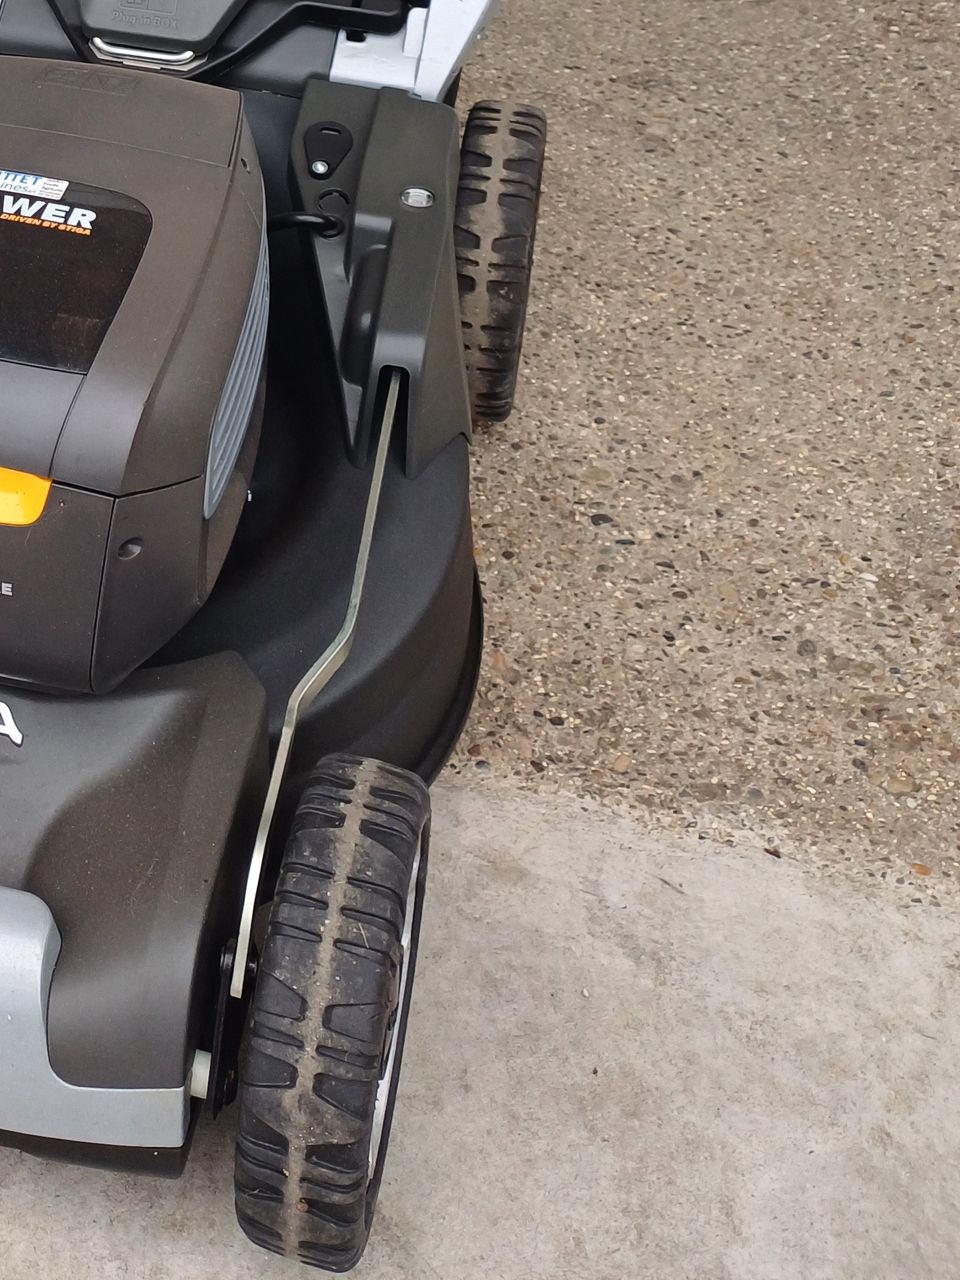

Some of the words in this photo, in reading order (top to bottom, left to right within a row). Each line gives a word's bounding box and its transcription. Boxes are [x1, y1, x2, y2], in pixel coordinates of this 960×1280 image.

[0, 213, 42, 226] DRIVEN
[42, 219, 58, 229] BY
[58, 223, 91, 236] STIGA
